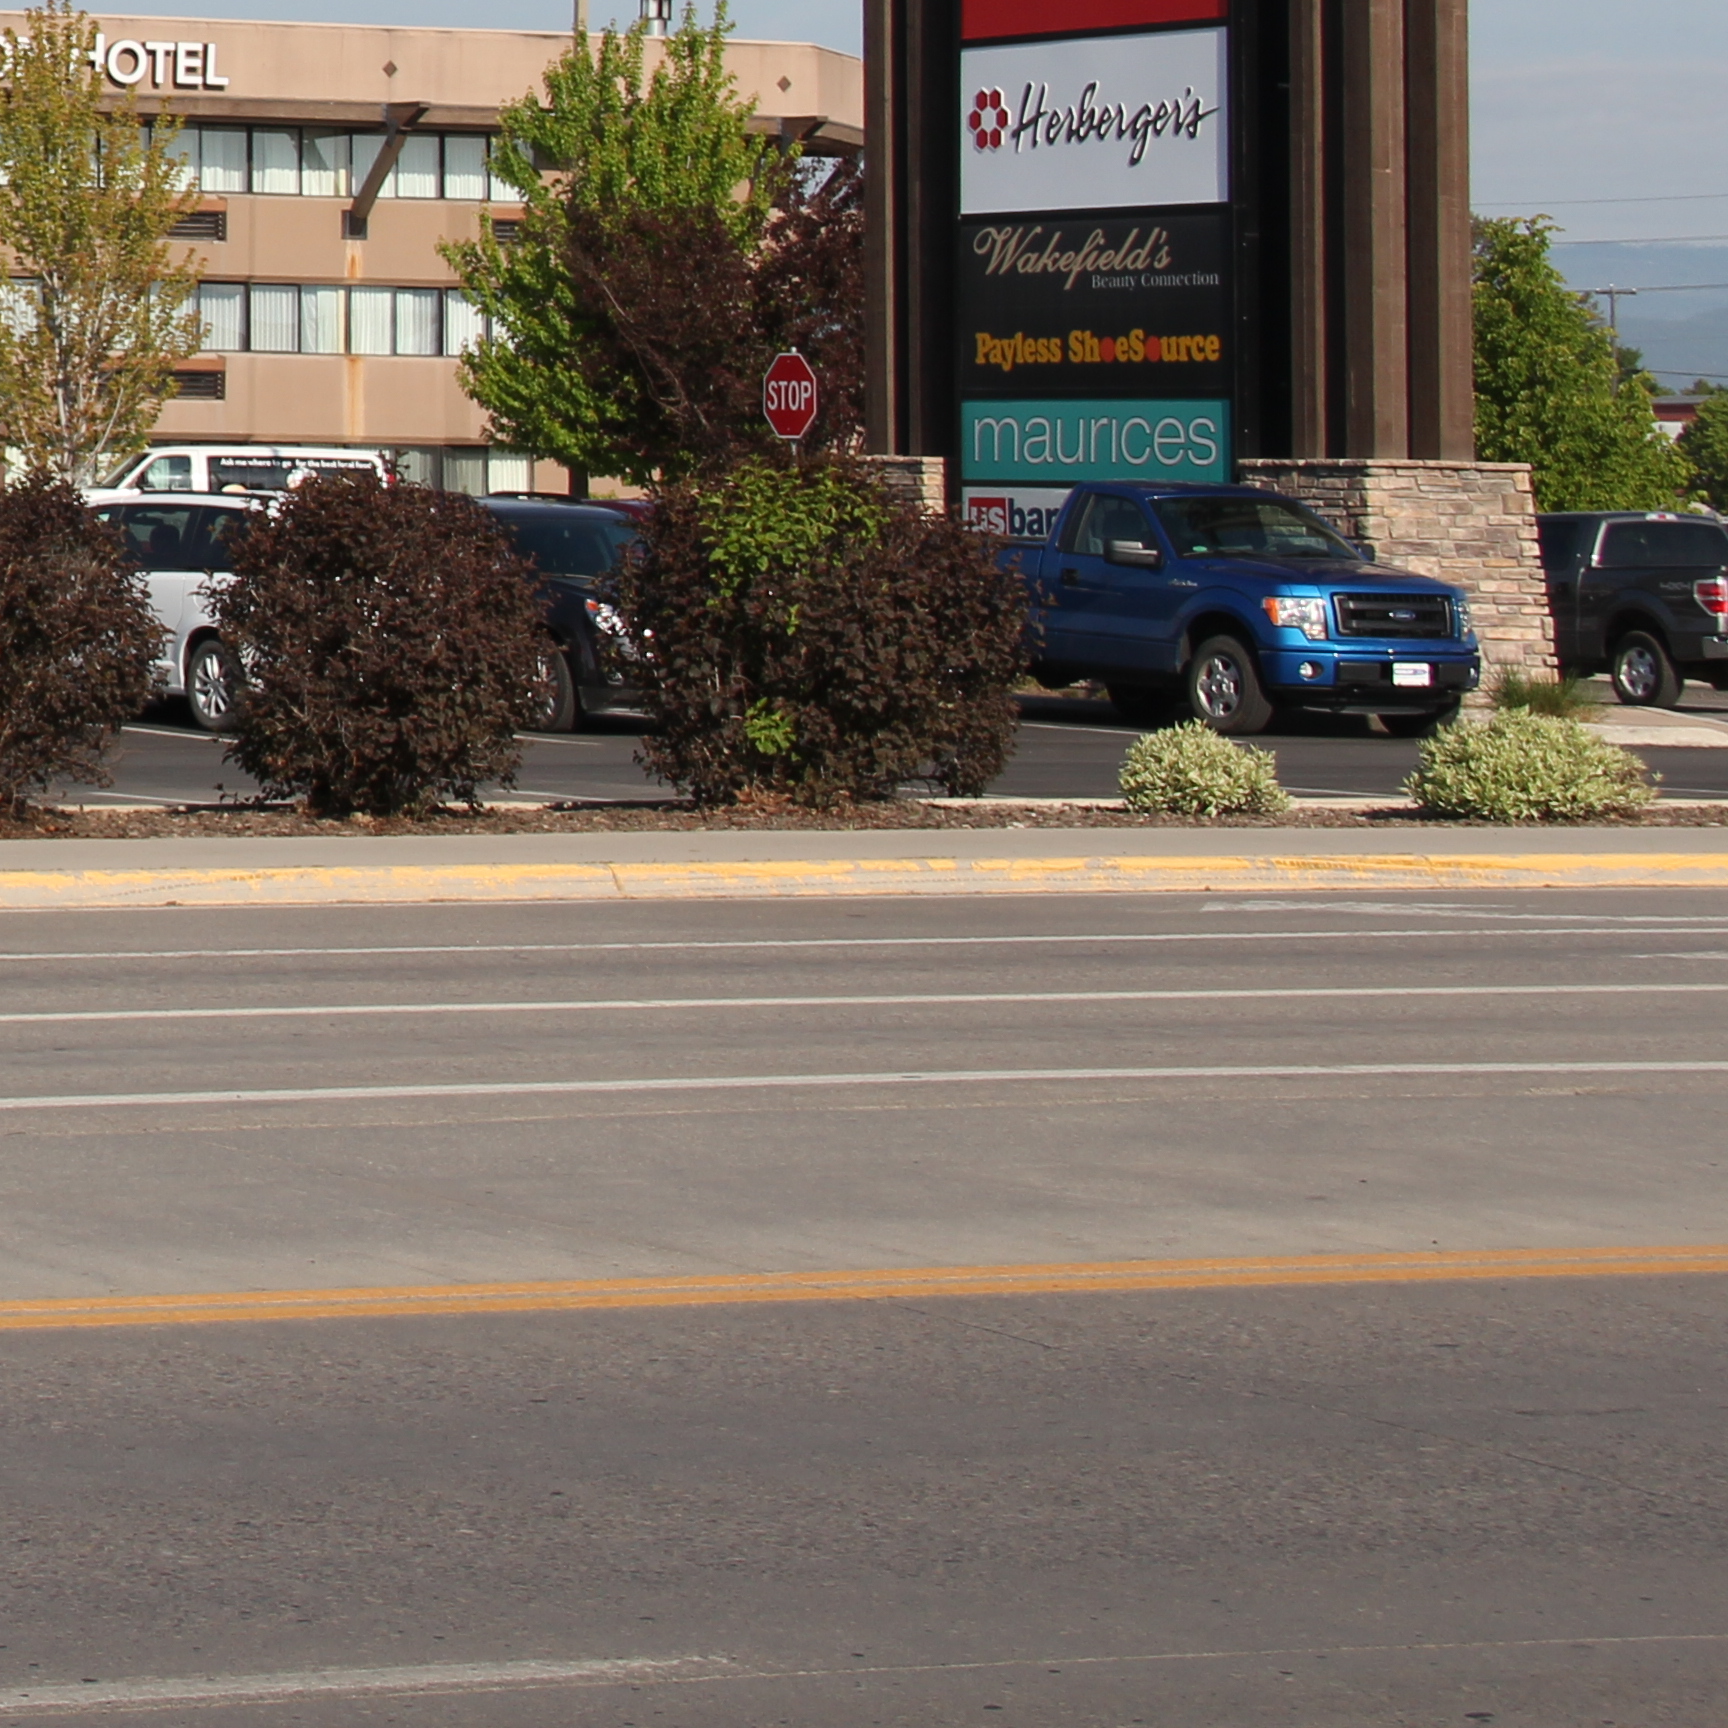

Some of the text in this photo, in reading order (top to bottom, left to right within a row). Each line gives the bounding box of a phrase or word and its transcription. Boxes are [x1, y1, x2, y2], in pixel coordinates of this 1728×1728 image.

[1011, 80, 1222, 167] Herberger's
[973, 226, 1172, 291] Wakefield's
[1091, 271, 1220, 291] Beauty Connection
[975, 331, 1062, 371] Payless
[767, 380, 812, 411] STOP
[974, 416, 1218, 466] maurices
